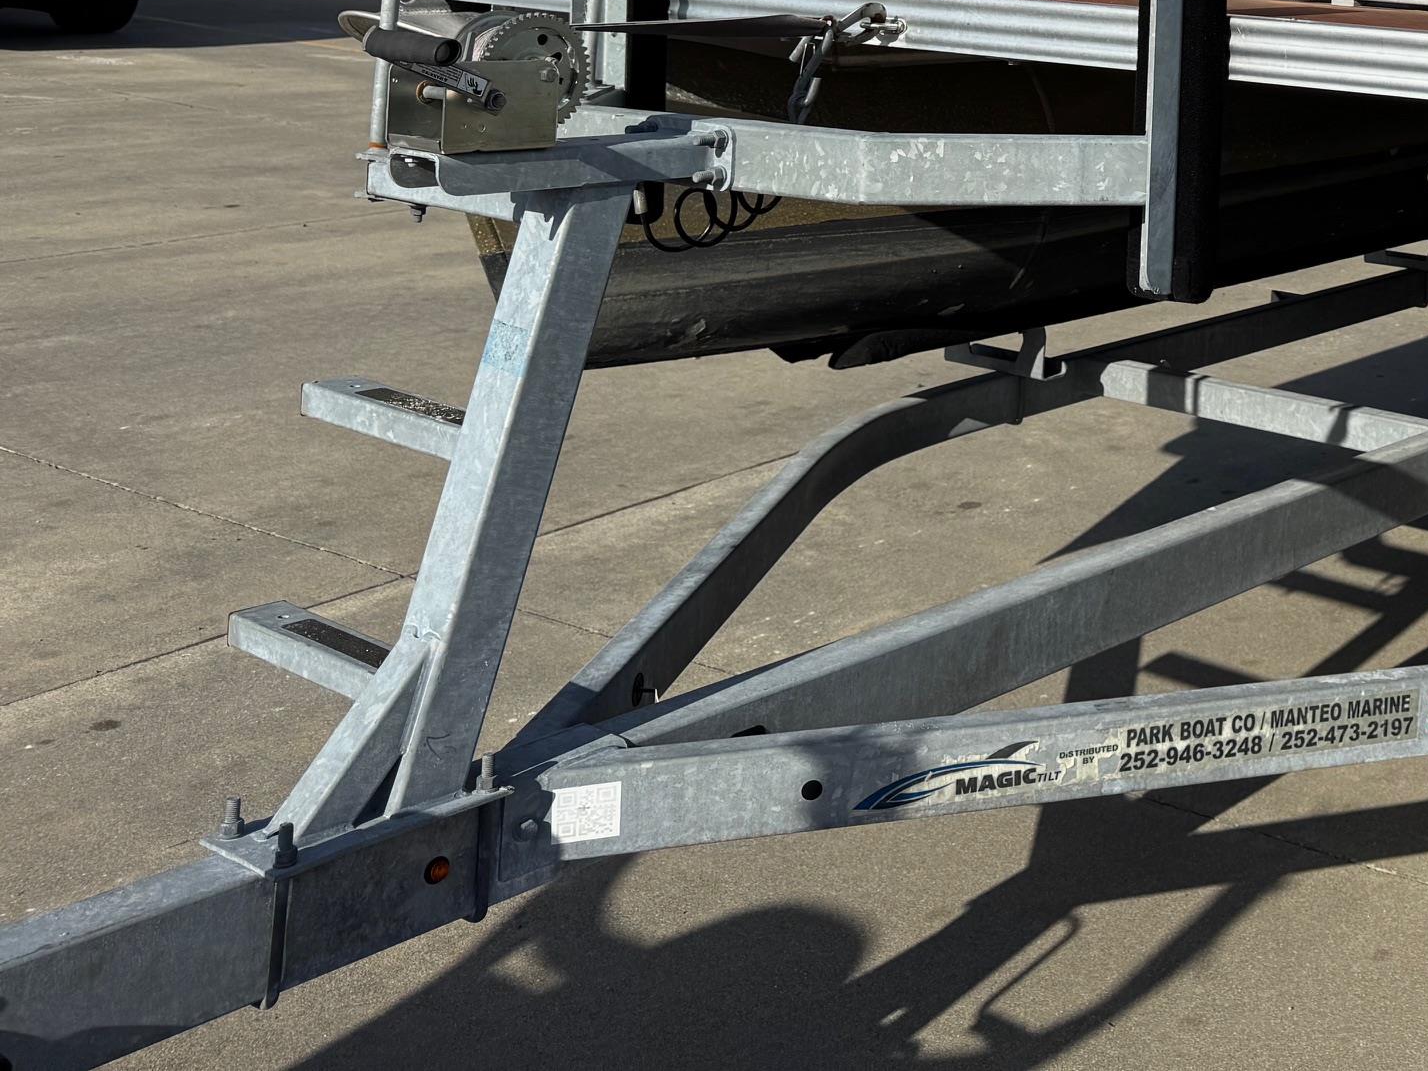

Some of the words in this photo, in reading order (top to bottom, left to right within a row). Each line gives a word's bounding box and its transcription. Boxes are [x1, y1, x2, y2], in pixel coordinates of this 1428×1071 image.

[1126, 723, 1175, 748] PARK
[1180, 717, 1227, 741] BOAT
[1231, 713, 1256, 734] CO
[1270, 702, 1342, 728] MANTEO
[1347, 694, 1411, 719] MARINE
[1082, 756, 1095, 765] BY
[1119, 735, 1263, 772] 252-946-3248
[1280, 716, 1414, 751] 252-473-2197
[955, 767, 1037, 795] MAGIC
[1037, 770, 1063, 783] TILT
